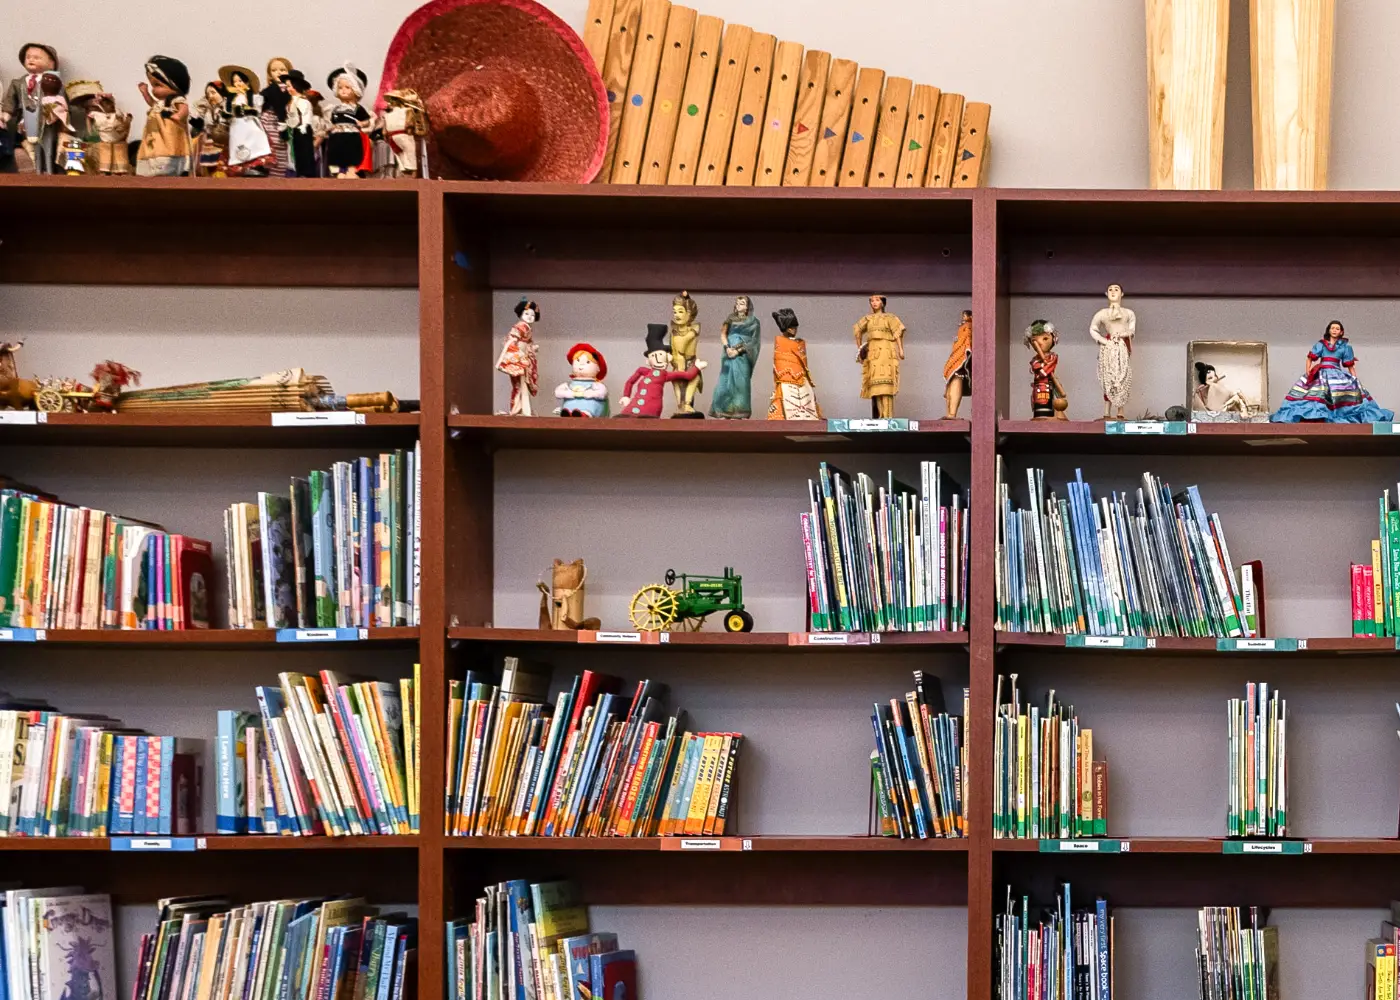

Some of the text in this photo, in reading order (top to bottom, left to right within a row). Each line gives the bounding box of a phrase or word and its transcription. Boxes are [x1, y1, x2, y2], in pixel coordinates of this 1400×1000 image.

[707, 756, 716, 782] FUTURE
[716, 756, 725, 782] FUTURE
[725, 756, 735, 784] FUTURE
[628, 771, 643, 802] HEROES
[1101, 973, 1109, 991] book
